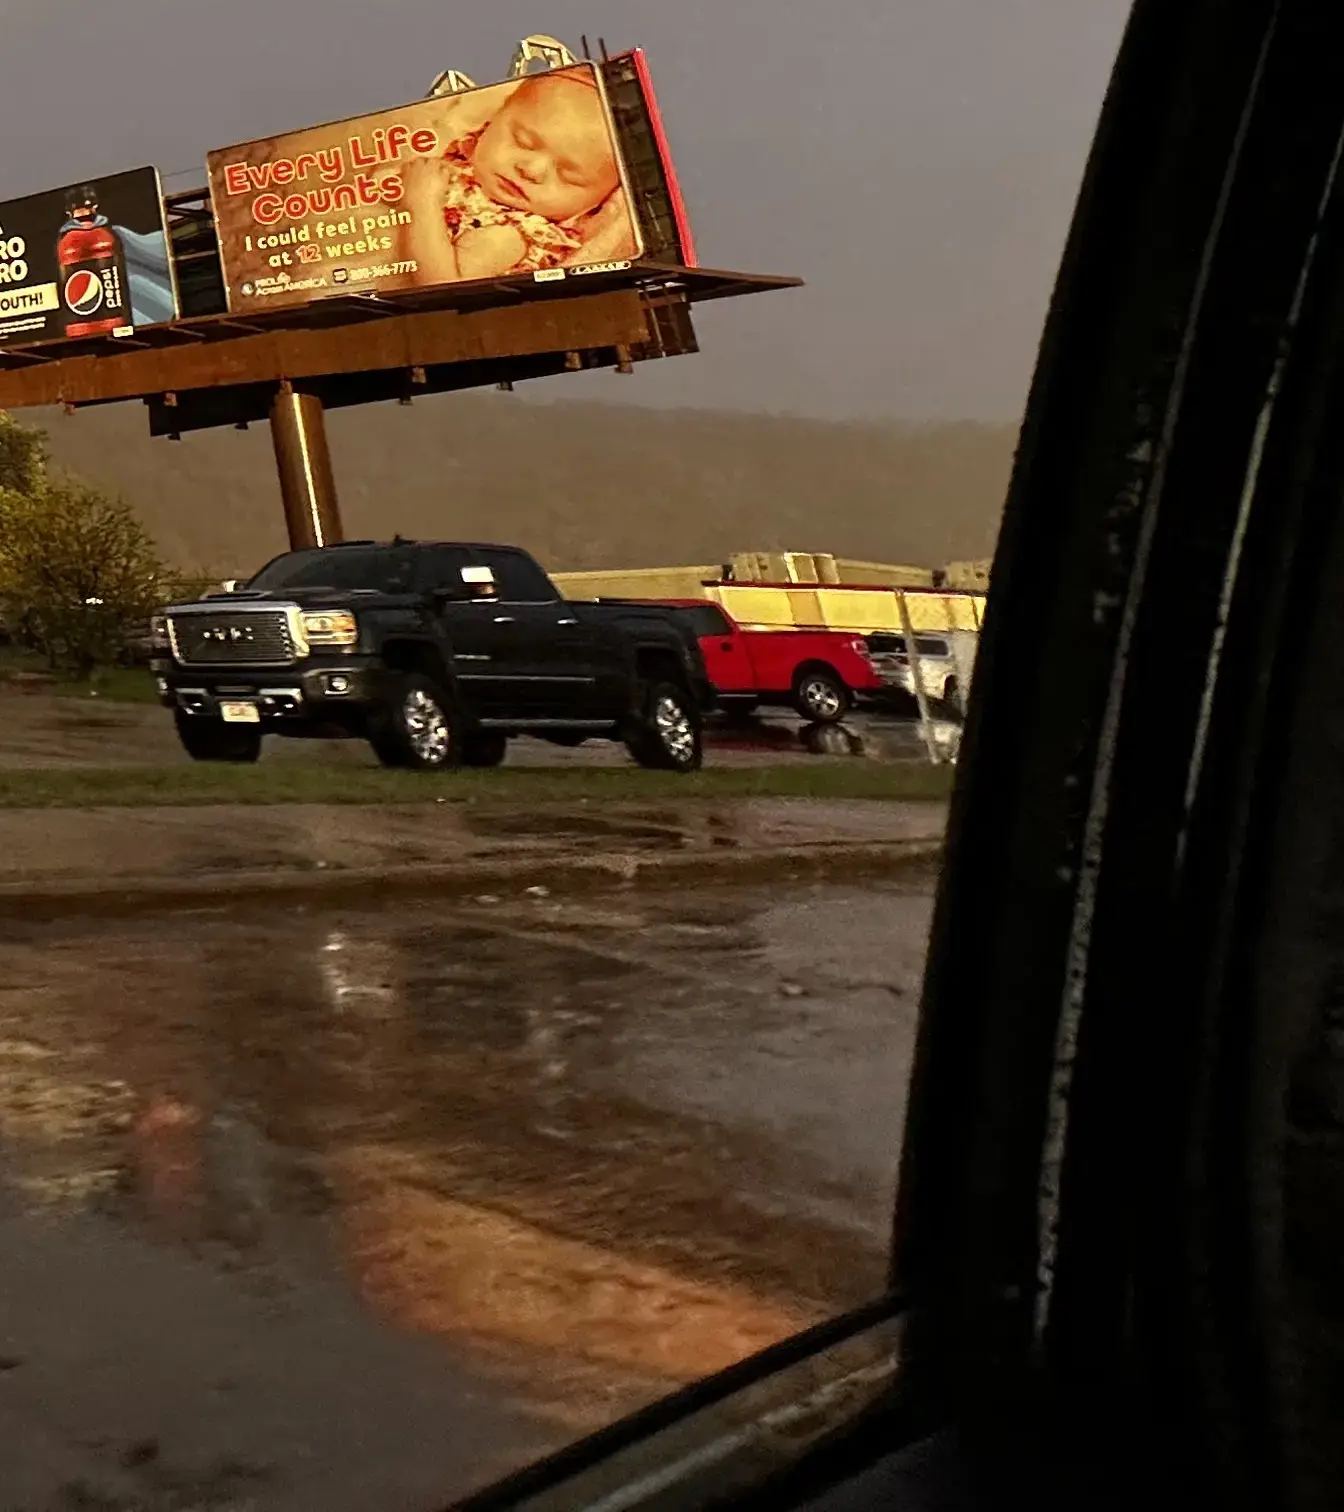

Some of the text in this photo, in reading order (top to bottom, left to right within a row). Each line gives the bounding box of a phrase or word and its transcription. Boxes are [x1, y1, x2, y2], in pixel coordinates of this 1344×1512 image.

[224, 124, 439, 195] Every Life
[252, 174, 405, 225] Counts
[245, 209, 412, 252] I could feel pain
[268, 235, 392, 267] at 12 weeks
